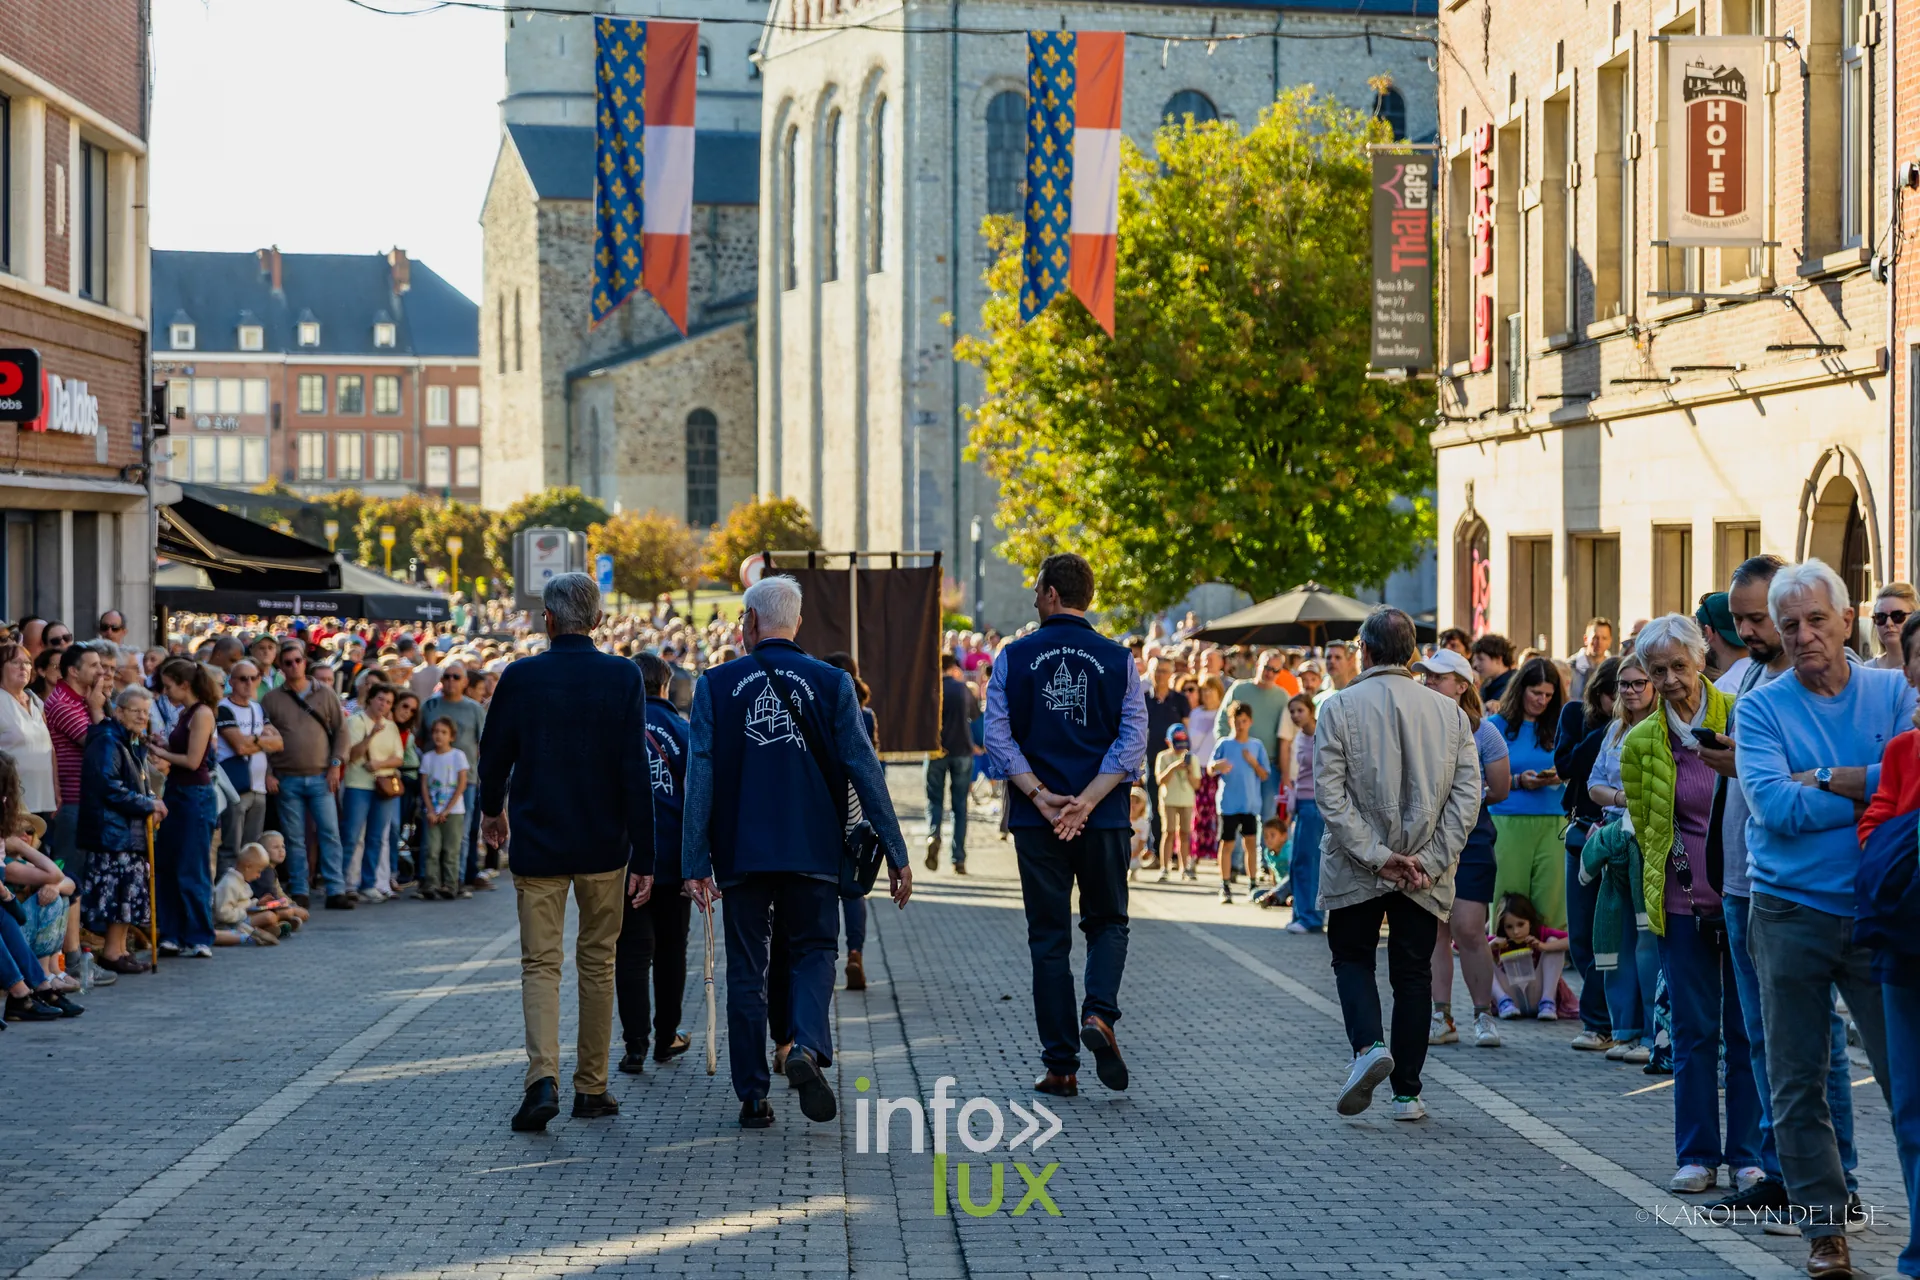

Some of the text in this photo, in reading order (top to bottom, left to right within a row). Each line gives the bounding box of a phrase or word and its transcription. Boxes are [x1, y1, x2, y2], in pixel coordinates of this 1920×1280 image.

[1706, 101, 1727, 217] HOTEL
[1030, 646, 1105, 674] Collégiale Ste Gertrude
[732, 668, 815, 701] Collégiale te Gertrude
